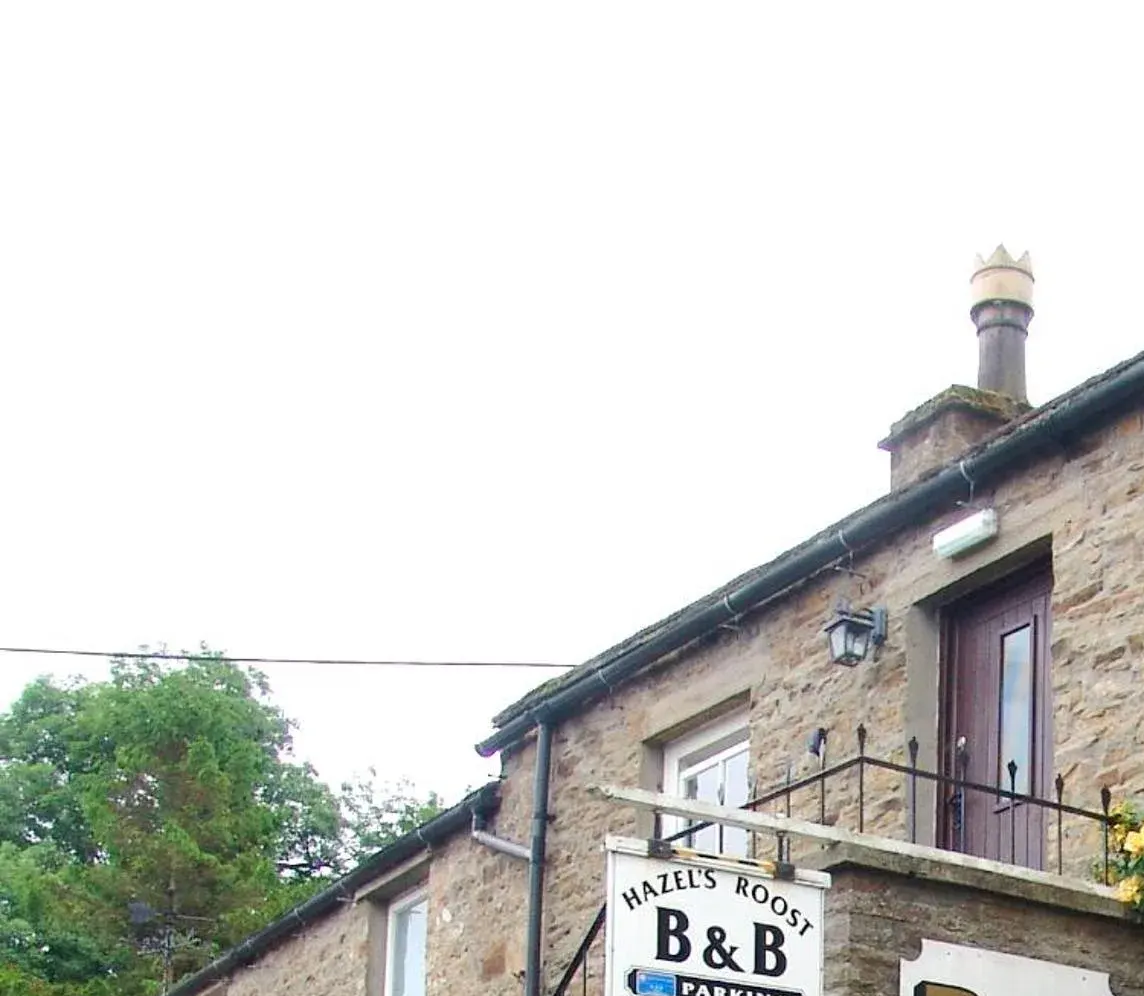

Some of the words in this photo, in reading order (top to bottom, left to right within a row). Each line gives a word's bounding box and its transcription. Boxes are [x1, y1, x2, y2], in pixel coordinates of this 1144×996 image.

[622, 867, 717, 911] HAZEL'S
[735, 876, 814, 937] ROOST
[654, 905, 788, 978] B&B
